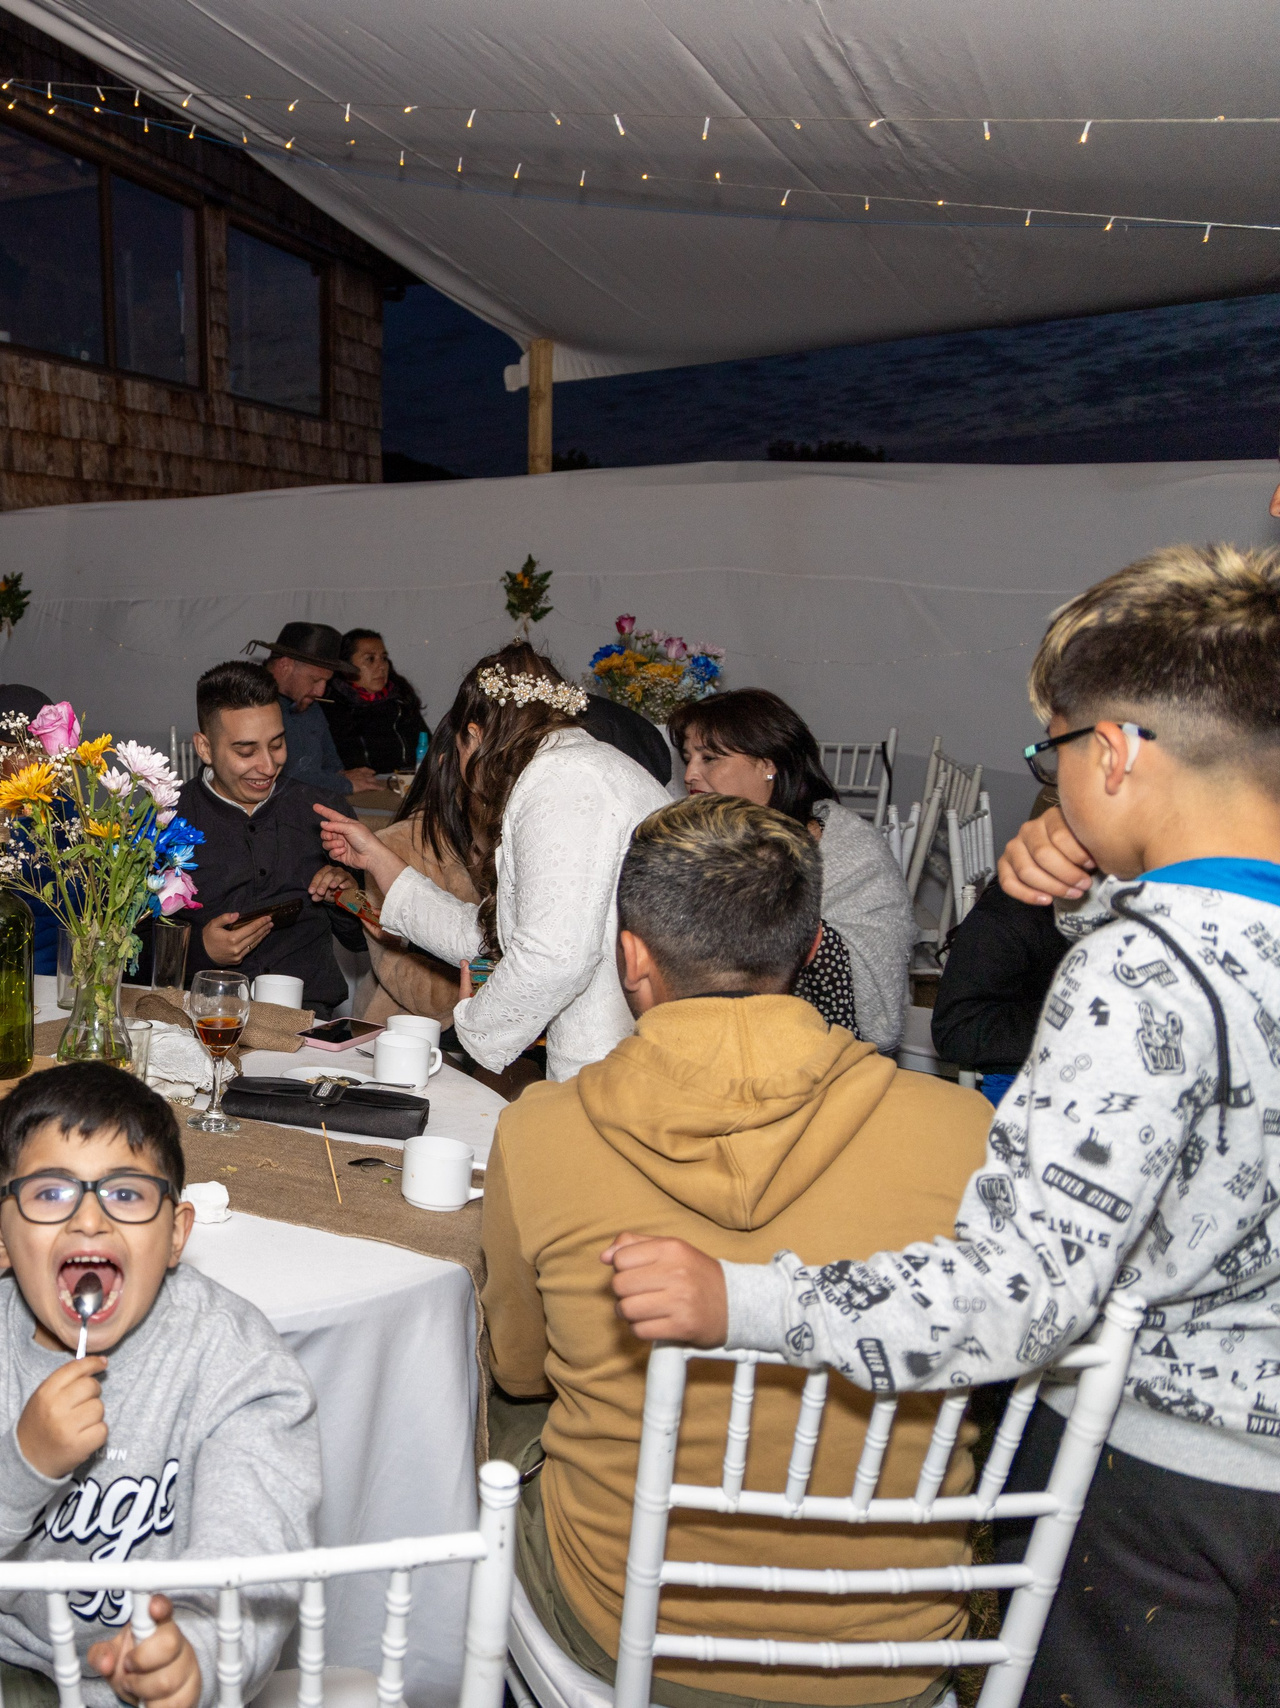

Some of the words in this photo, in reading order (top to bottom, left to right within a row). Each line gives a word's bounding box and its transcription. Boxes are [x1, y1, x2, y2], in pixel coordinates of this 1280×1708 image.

[1045, 1166, 1086, 1198] NEVER
[1086, 1188, 1117, 1214] GIVE
[1116, 1202, 1132, 1220] UP
[1047, 1217, 1112, 1249] START
[861, 1340, 885, 1373] NEVER
